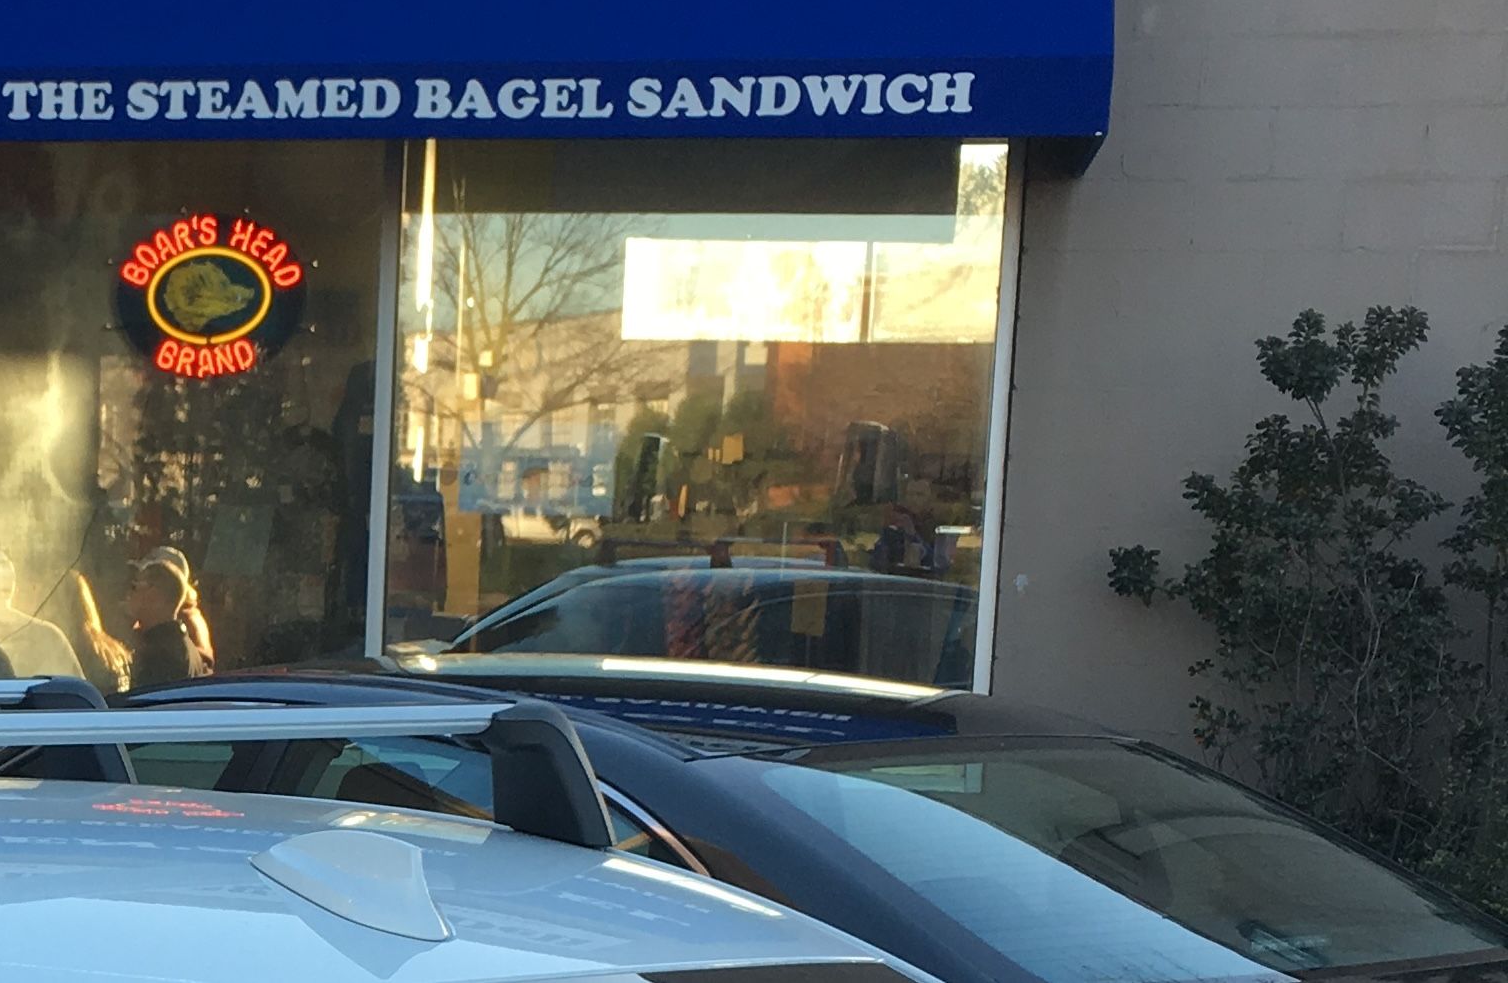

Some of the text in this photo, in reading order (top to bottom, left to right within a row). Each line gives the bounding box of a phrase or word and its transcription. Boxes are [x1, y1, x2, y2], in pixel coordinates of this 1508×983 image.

[2, 80, 113, 120] THE
[126, 78, 401, 120] STEAMED
[414, 78, 613, 119] BAGEL
[627, 72, 975, 117] SANDWICH
[122, 214, 301, 287] BOAR'S HEAD
[156, 339, 254, 378] BRAND
